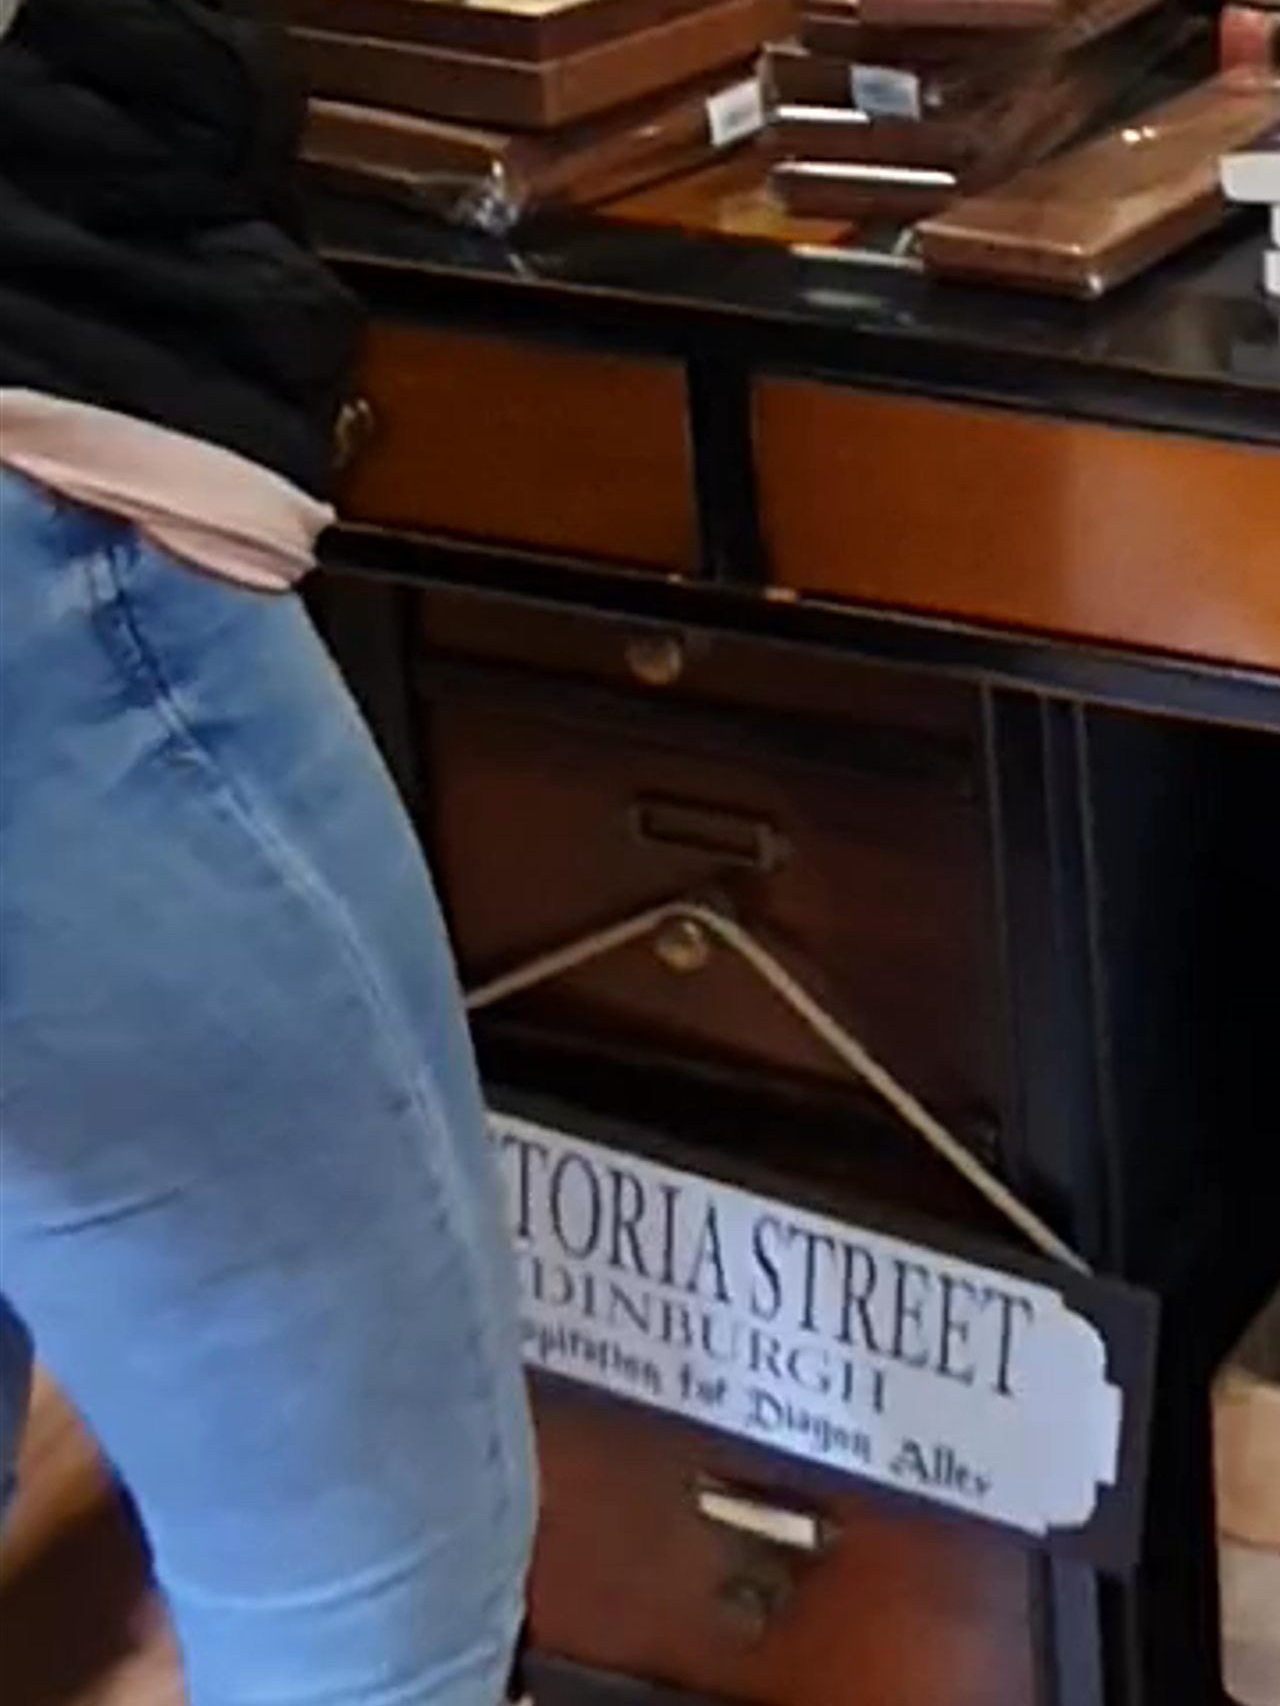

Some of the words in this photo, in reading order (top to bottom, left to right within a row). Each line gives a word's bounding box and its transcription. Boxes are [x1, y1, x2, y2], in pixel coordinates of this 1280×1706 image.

[498, 1131, 731, 1306] TORIA
[749, 1213, 1036, 1398] STREET
[530, 1254, 887, 1416] DINBURGH
[535, 1326, 662, 1397] piration
[889, 1439, 995, 1499] Alley
